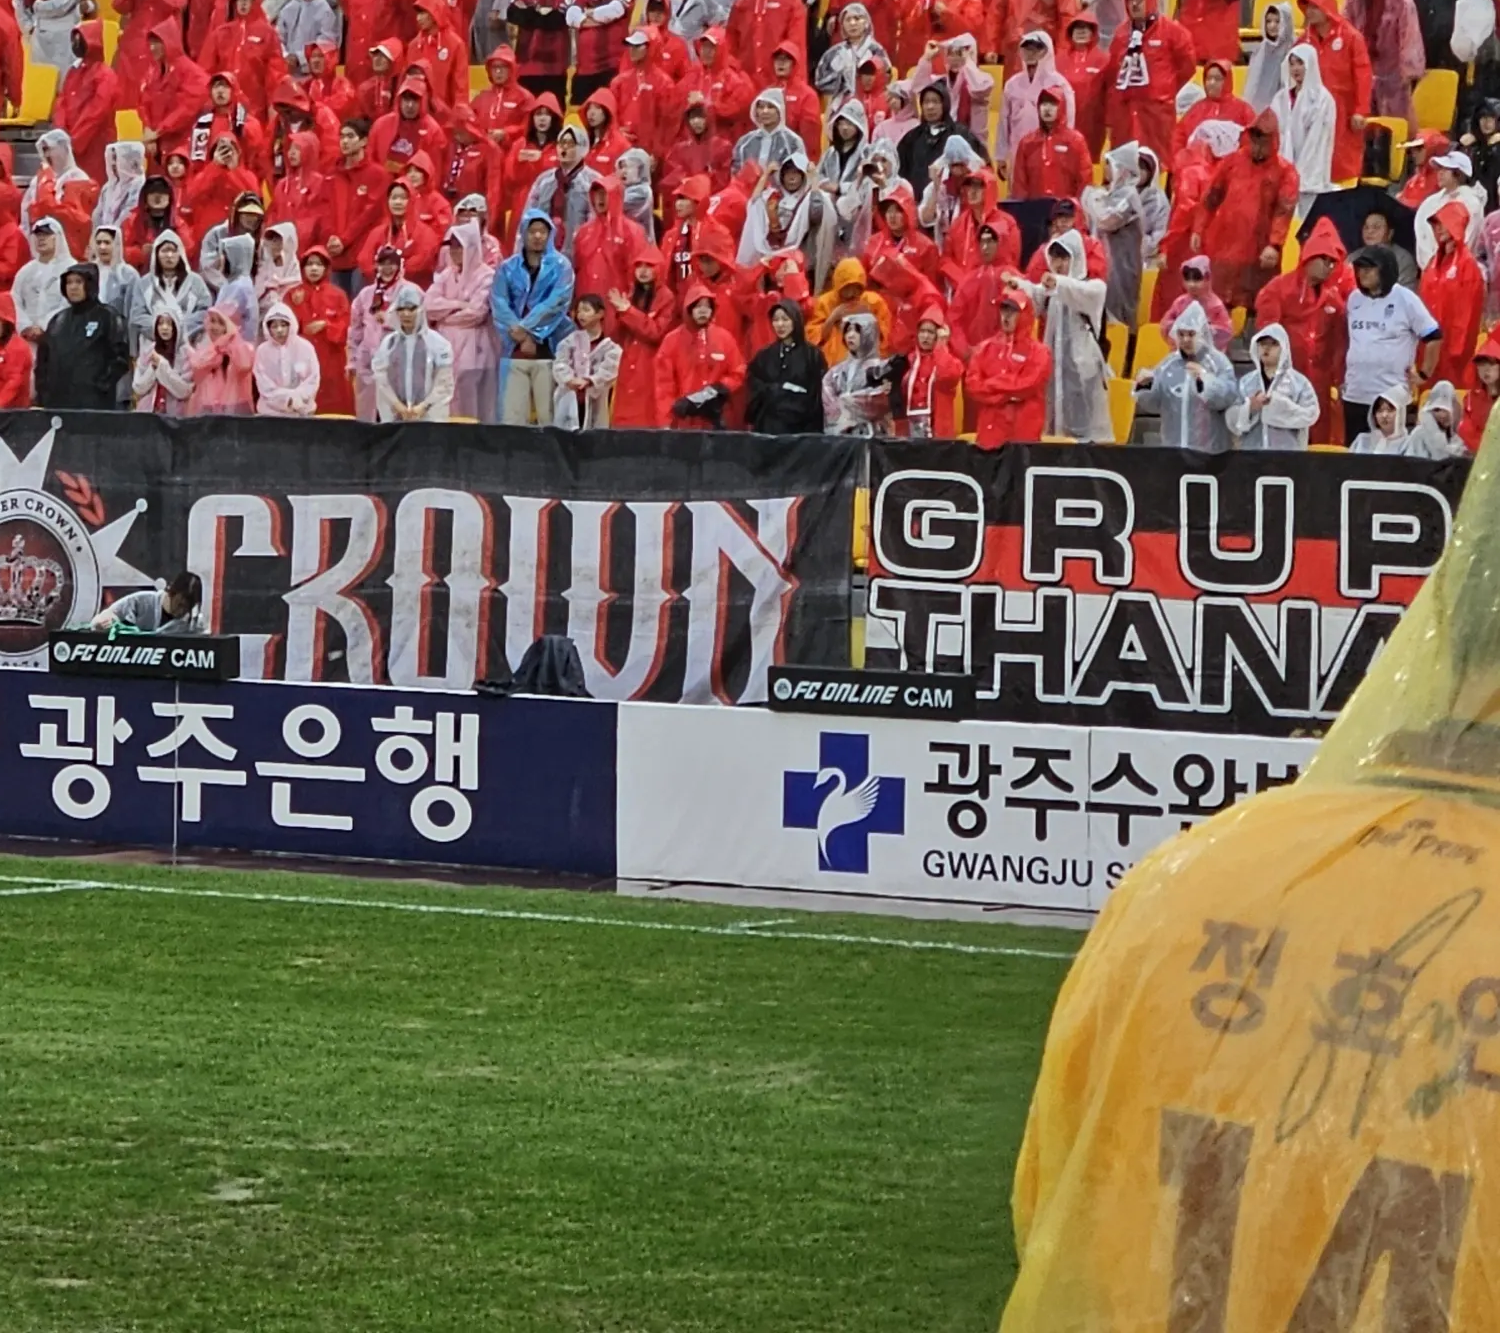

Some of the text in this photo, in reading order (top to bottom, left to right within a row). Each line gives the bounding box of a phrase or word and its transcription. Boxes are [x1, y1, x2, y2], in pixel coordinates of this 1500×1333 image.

[23, 497, 78, 541] CROWN
[186, 487, 800, 706] CROWN
[70, 644, 215, 669] FC ONLINE CAM
[792, 681, 953, 709] FC ONLINE CAM
[19, 694, 480, 843] 광주은행
[924, 741, 1304, 848] 광주수완
[923, 850, 1093, 888] GWANGJU
